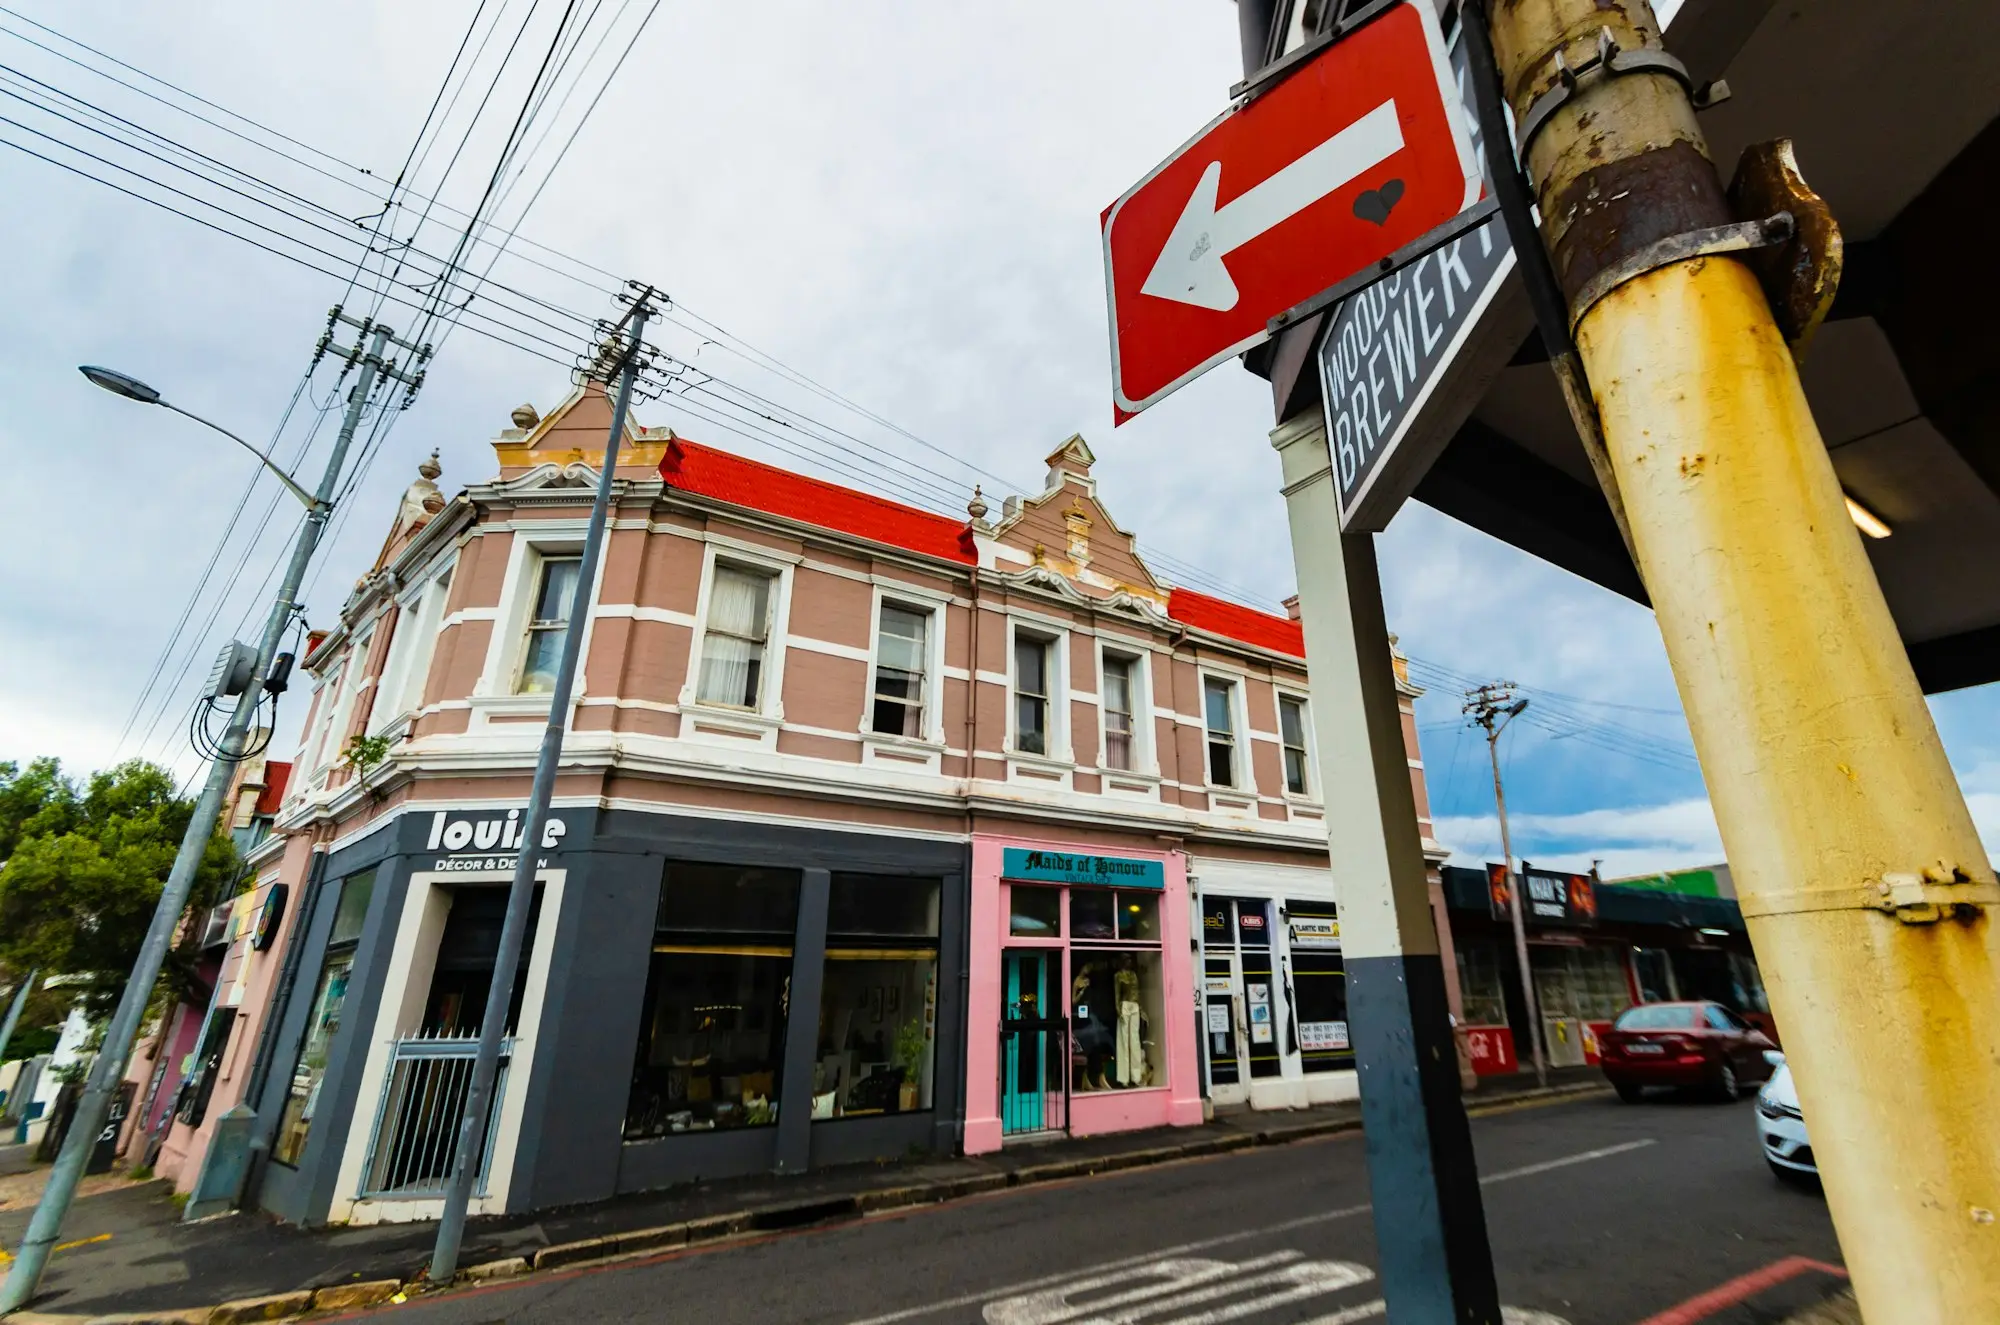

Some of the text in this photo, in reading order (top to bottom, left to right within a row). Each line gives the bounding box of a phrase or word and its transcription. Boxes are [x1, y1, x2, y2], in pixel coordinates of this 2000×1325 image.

[435, 858, 548, 871] DÉCOR & DEN
[1025, 851, 1146, 877] Maids of Honour
